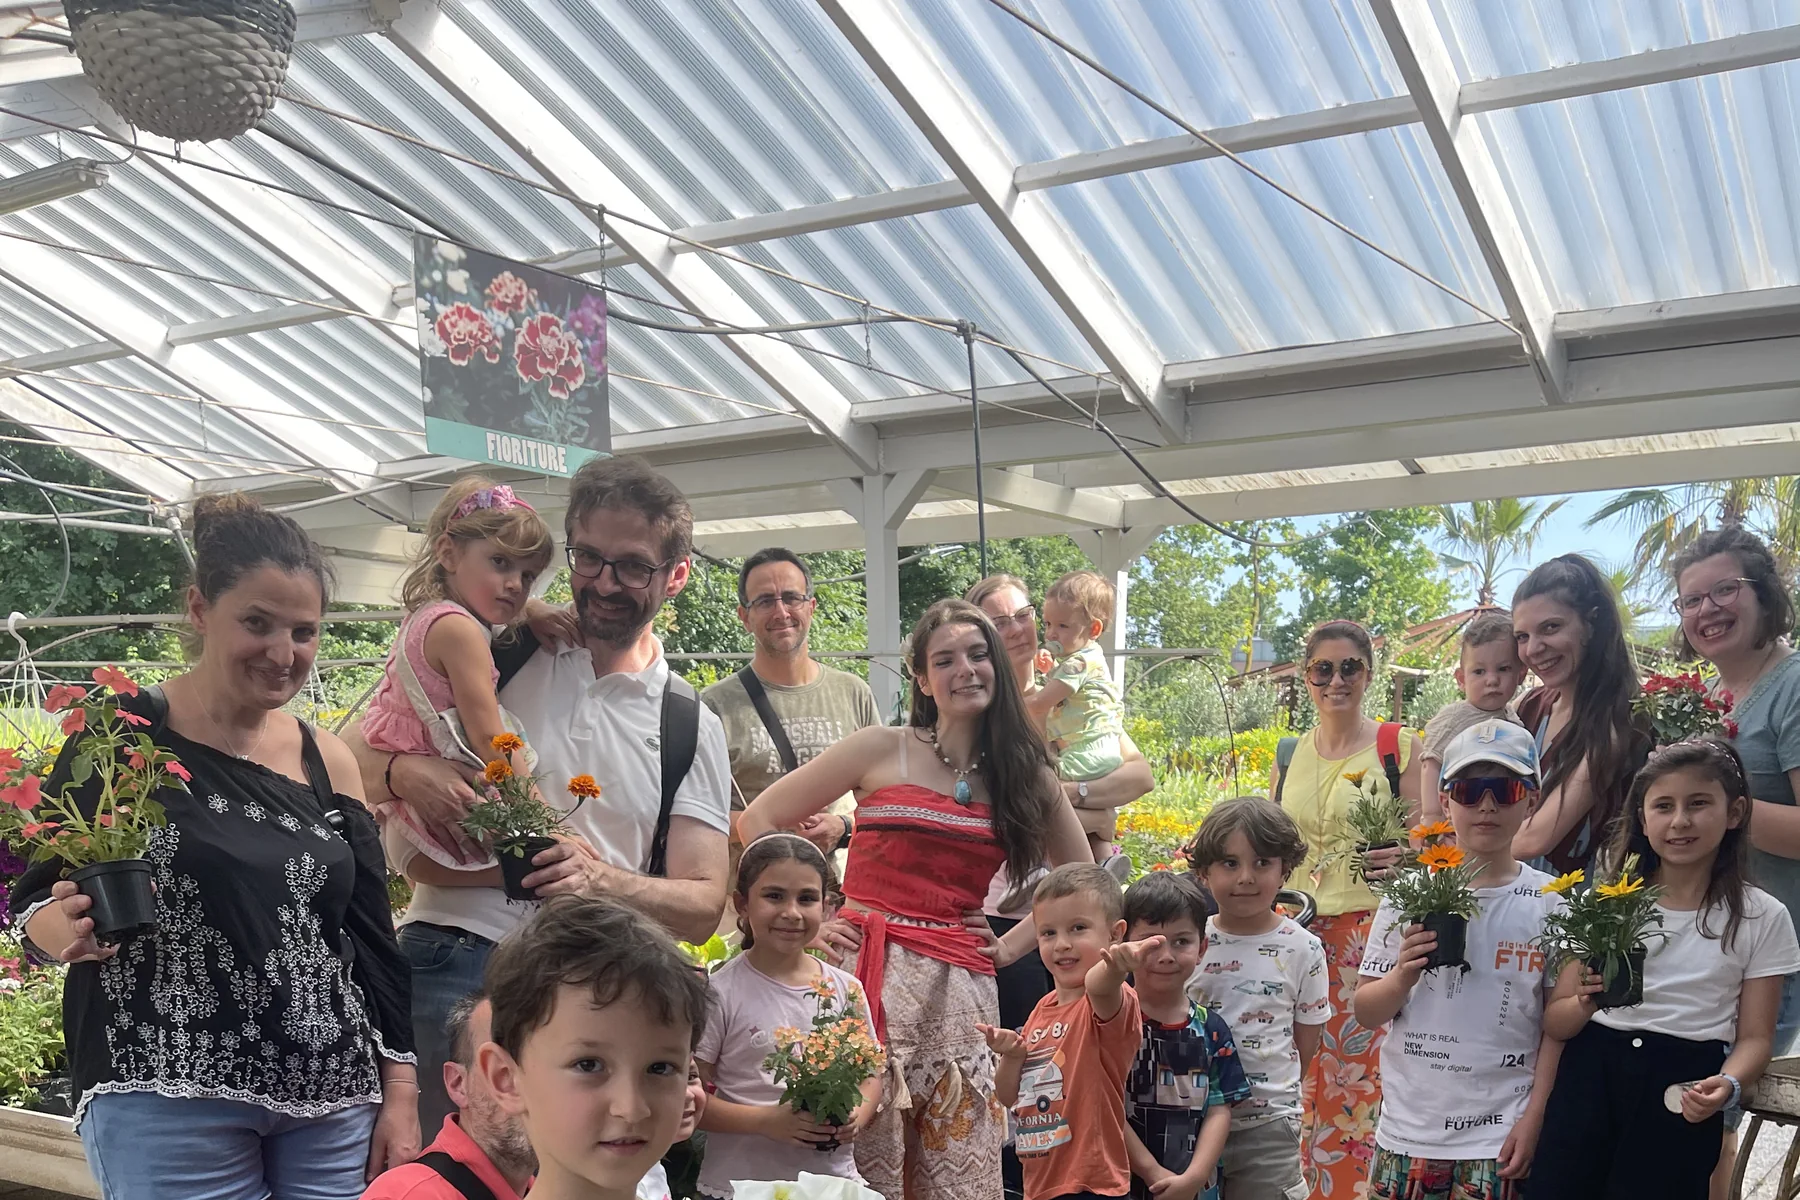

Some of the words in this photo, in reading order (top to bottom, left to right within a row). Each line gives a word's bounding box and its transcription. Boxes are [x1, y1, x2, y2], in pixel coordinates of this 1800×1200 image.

[485, 431, 568, 473] FIORITURE
[1429, 1034, 1438, 1042] IS
[1438, 1035, 1461, 1044] REAL
[1404, 1041, 1424, 1051] NEW
[1403, 1048, 1451, 1060] DIMENSION
[1430, 1062, 1447, 1072] stay
[1447, 1064, 1473, 1073] digital
[1445, 1114, 1503, 1131] FUTURE
